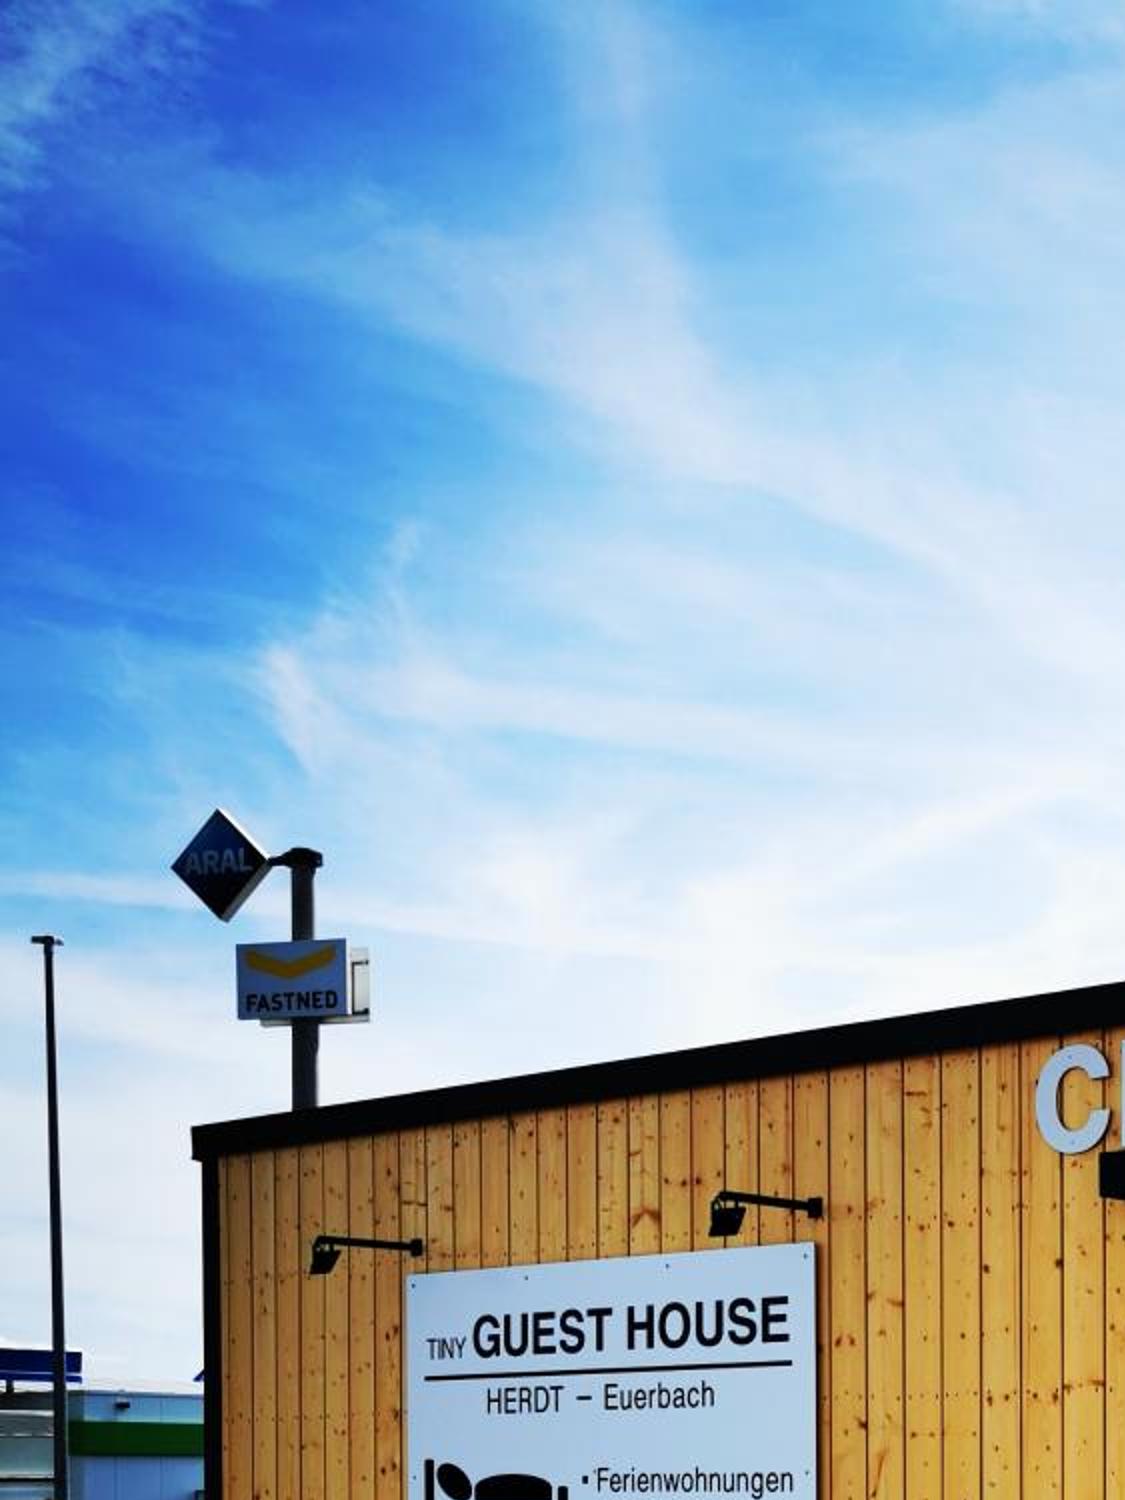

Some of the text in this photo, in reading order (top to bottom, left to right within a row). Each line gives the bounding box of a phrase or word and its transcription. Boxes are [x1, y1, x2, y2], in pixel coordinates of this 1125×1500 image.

[185, 847, 253, 876] ARAL
[245, 990, 338, 1013] FASTNED
[426, 1296, 790, 1361] TINY GUEST HOUSE
[487, 1385, 564, 1415] HERDT
[604, 1381, 715, 1411] Euerbach
[597, 1467, 794, 1500] Ferienwohnungen
